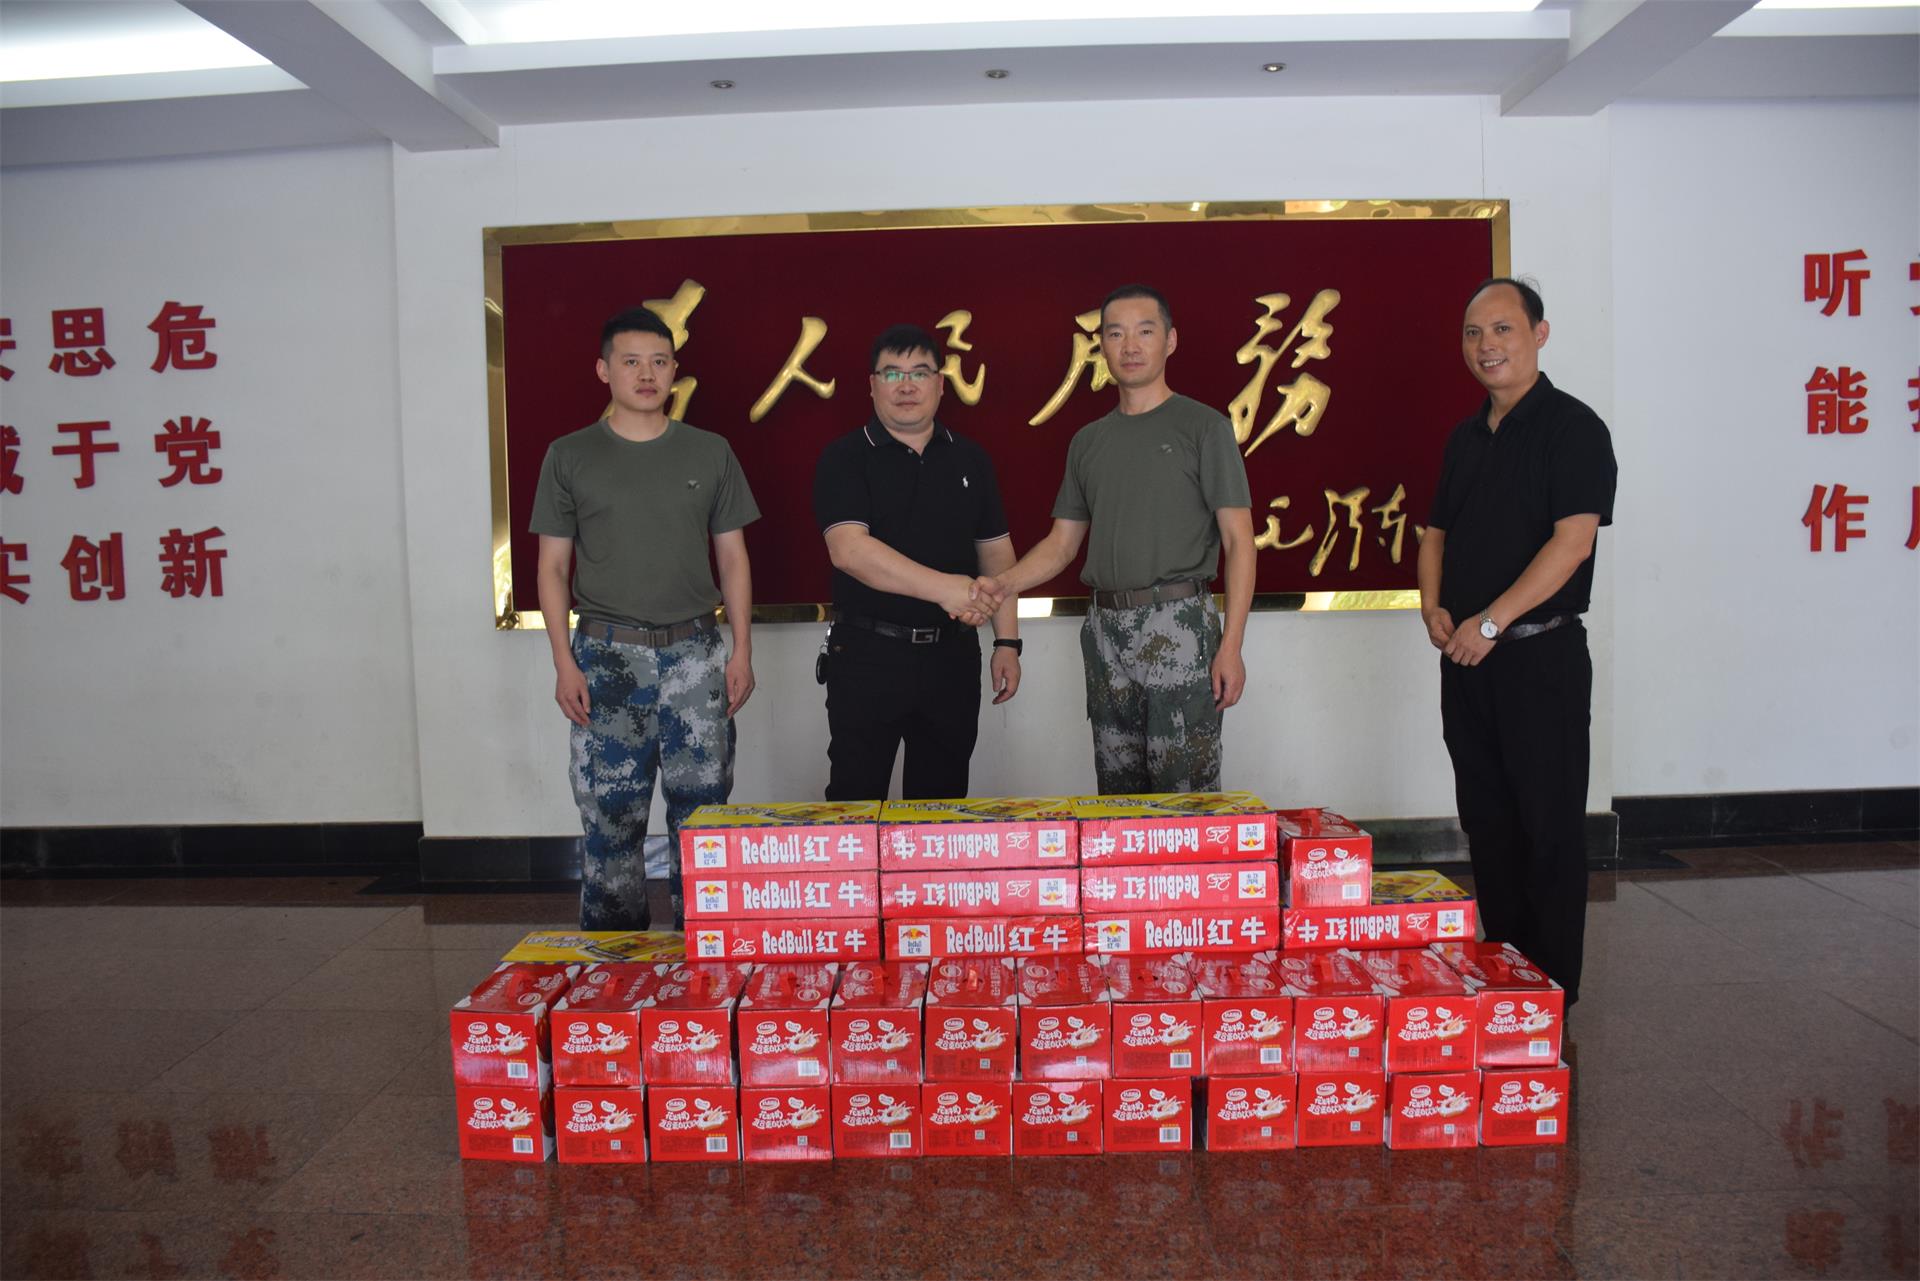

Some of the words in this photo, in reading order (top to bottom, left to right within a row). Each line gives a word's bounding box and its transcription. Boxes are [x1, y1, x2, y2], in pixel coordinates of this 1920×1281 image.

[1804, 249, 1920, 317] 听
[0, 301, 218, 382] 思危
[1805, 366, 1920, 434] 能
[1801, 483, 1920, 552] 作
[741, 834, 801, 864] RedBull
[948, 834, 999, 859] RedBull
[1148, 828, 1199, 853] RedBull
[743, 880, 801, 909] RedBull
[948, 882, 999, 906] RedBull
[1149, 875, 1199, 900] RedBull
[762, 929, 813, 954] RedBull
[946, 924, 1004, 953] RedBull
[1145, 918, 1204, 947] RedBull
[1350, 915, 1399, 941] RedBull
